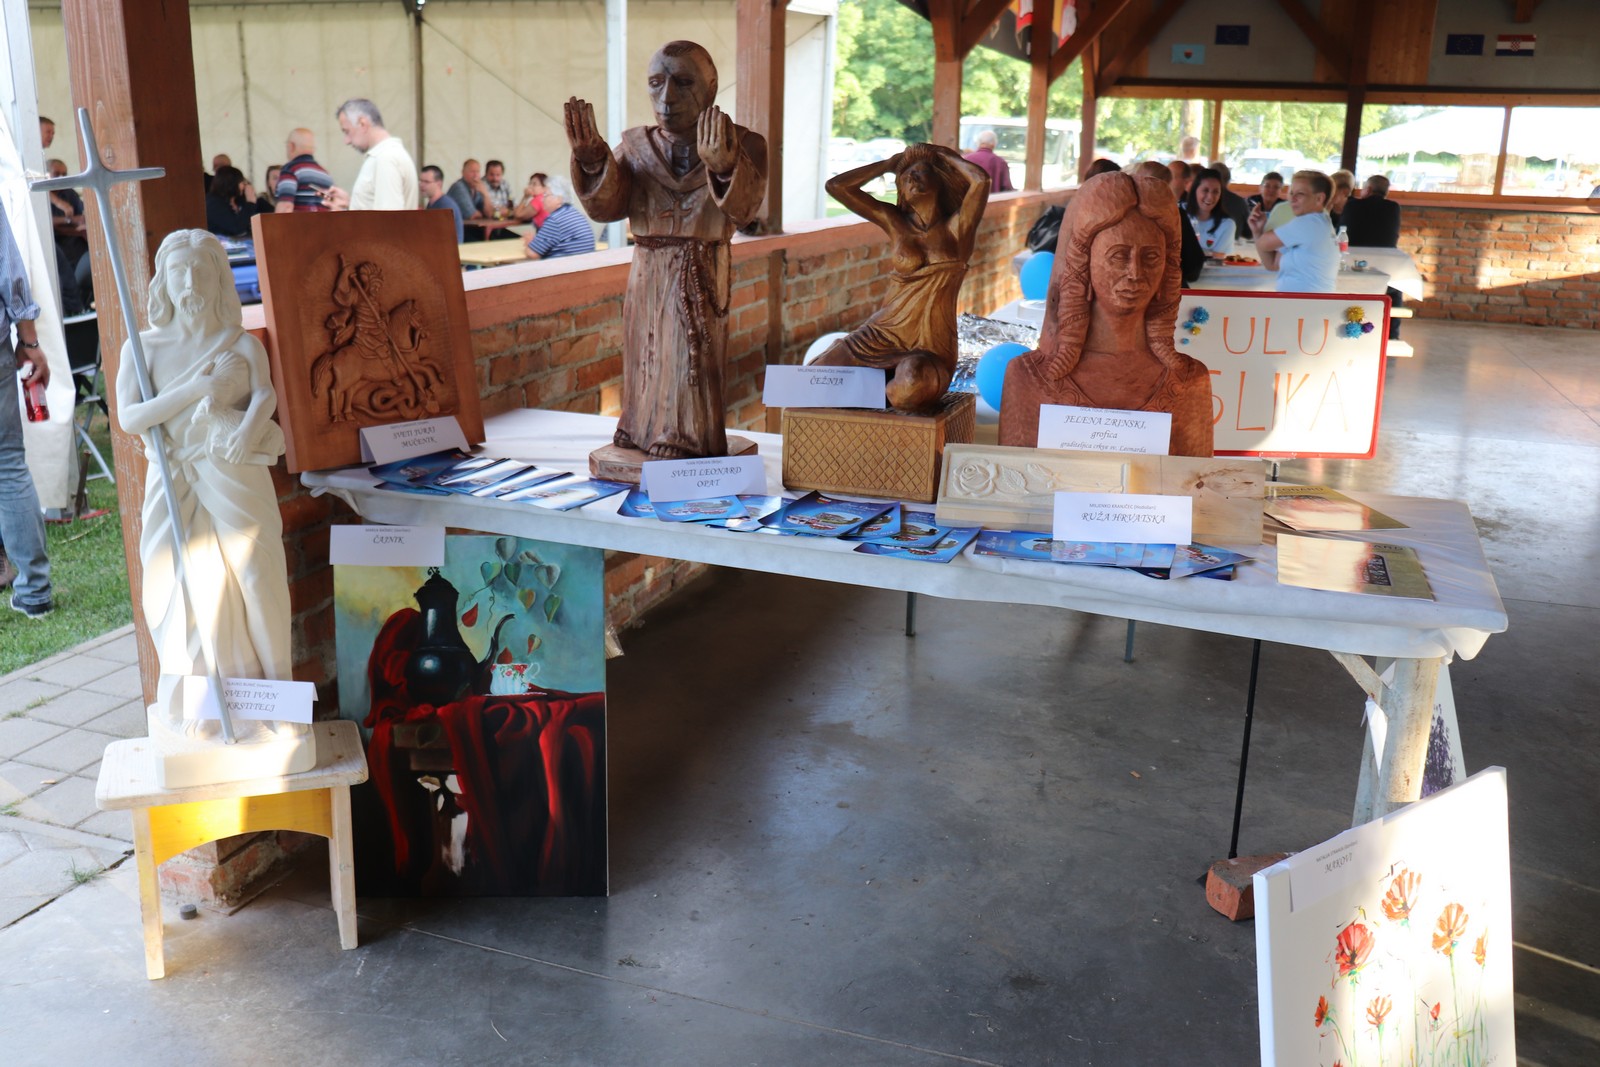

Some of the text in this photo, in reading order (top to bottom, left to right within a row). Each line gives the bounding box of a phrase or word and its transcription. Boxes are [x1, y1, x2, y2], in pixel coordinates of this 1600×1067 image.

[810, 376, 844, 386] ČEŽNJA
[1064, 415, 1102, 425] JELENA
[393, 430, 413, 440] SVETI
[1090, 430, 1118, 440] grofica
[401, 437, 438, 448] MUČENIK
[1060, 441, 1092, 449] graditeljica
[671, 466, 742, 478] SVETI LEONARD
[696, 479, 721, 488] OPAT
[1081, 511, 1166, 525] RUŽA HRVATSKA
[372, 535, 405, 545] ČAJNIK
[224, 689, 279, 700] SVETI IVAN
[226, 701, 276, 713] KRSTITELJ
